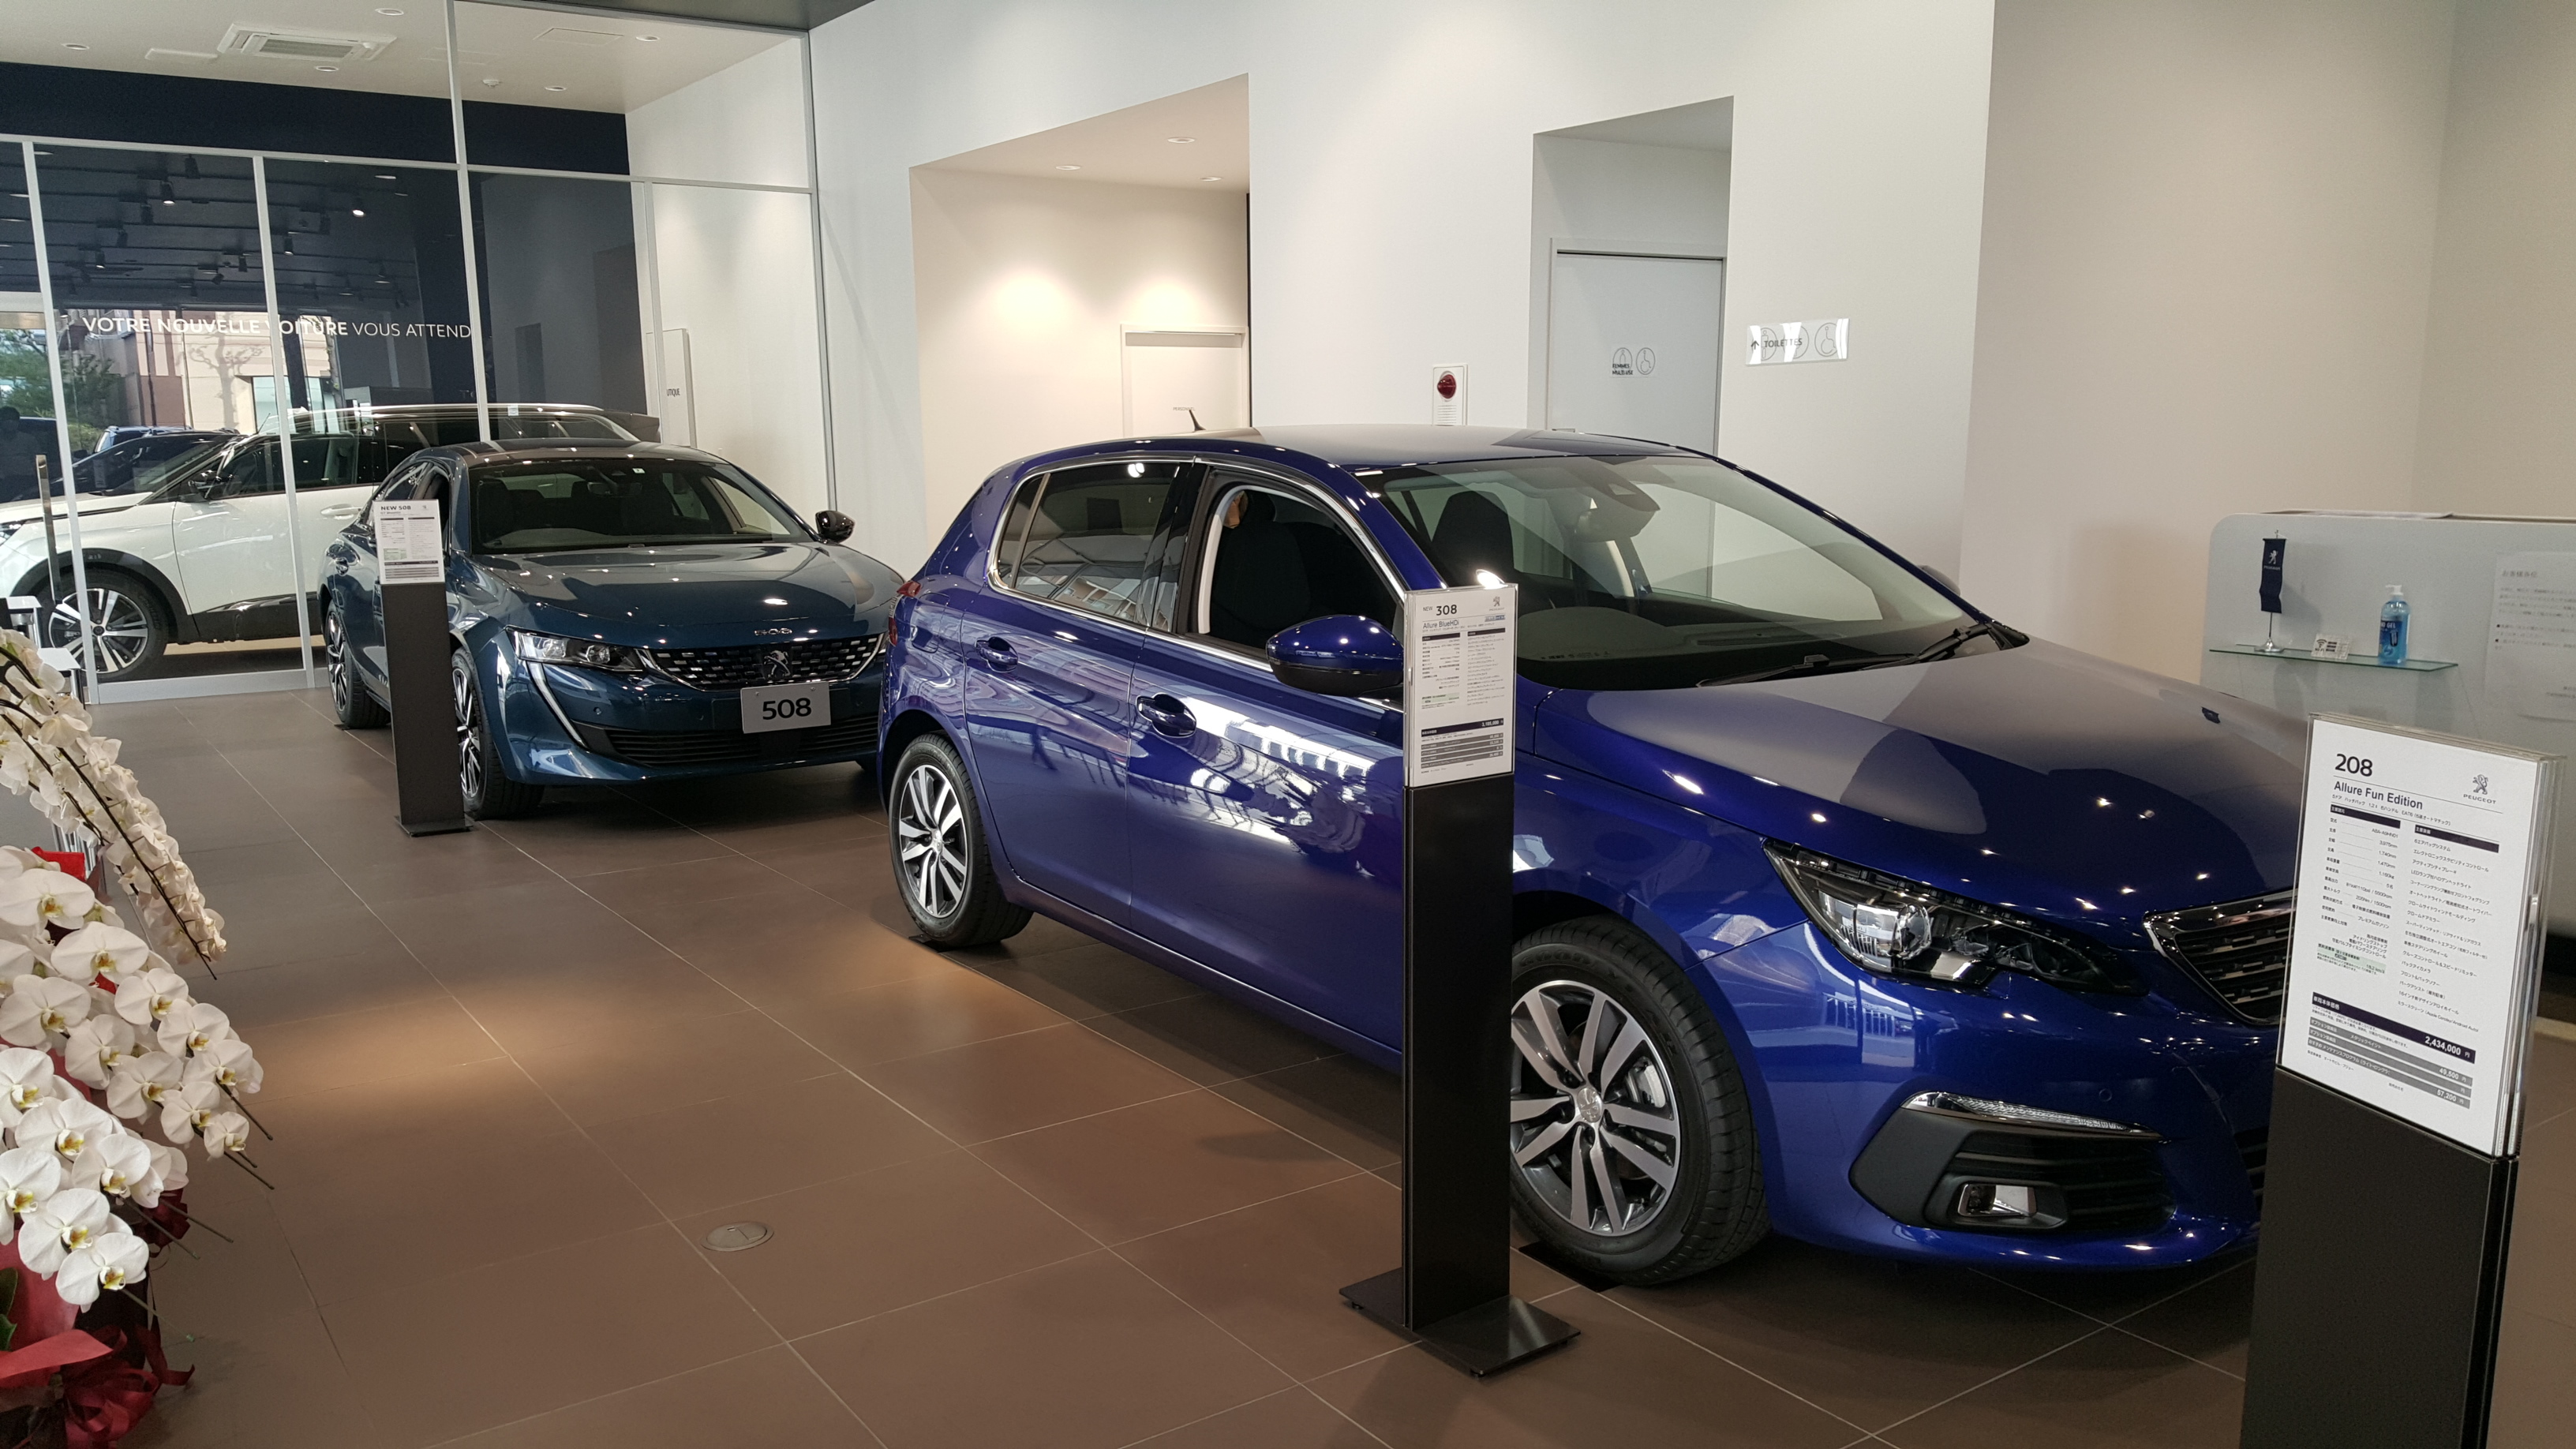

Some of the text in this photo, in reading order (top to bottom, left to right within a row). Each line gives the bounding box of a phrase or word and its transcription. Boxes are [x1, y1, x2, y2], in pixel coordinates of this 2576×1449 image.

[82, 317, 151, 332] VOTRE
[158, 318, 260, 334] NOUVELLE
[352, 322, 400, 336] VOUS
[406, 324, 472, 338] ATTEND
[1764, 338, 1803, 348] TOILETTES
[1436, 605, 1457, 616] 308
[1439, 619, 1460, 627] BlueHDi
[763, 698, 811, 720] 508
[2334, 752, 2373, 777] 208
[2333, 780, 2423, 810] Allure Fun Edition
[2462, 793, 2496, 805] PEUGEOT
[2424, 1035, 2462, 1058] 2,434,000
[2438, 1066, 2459, 1081] 49,500
[2436, 1088, 2457, 1103] 57,200
